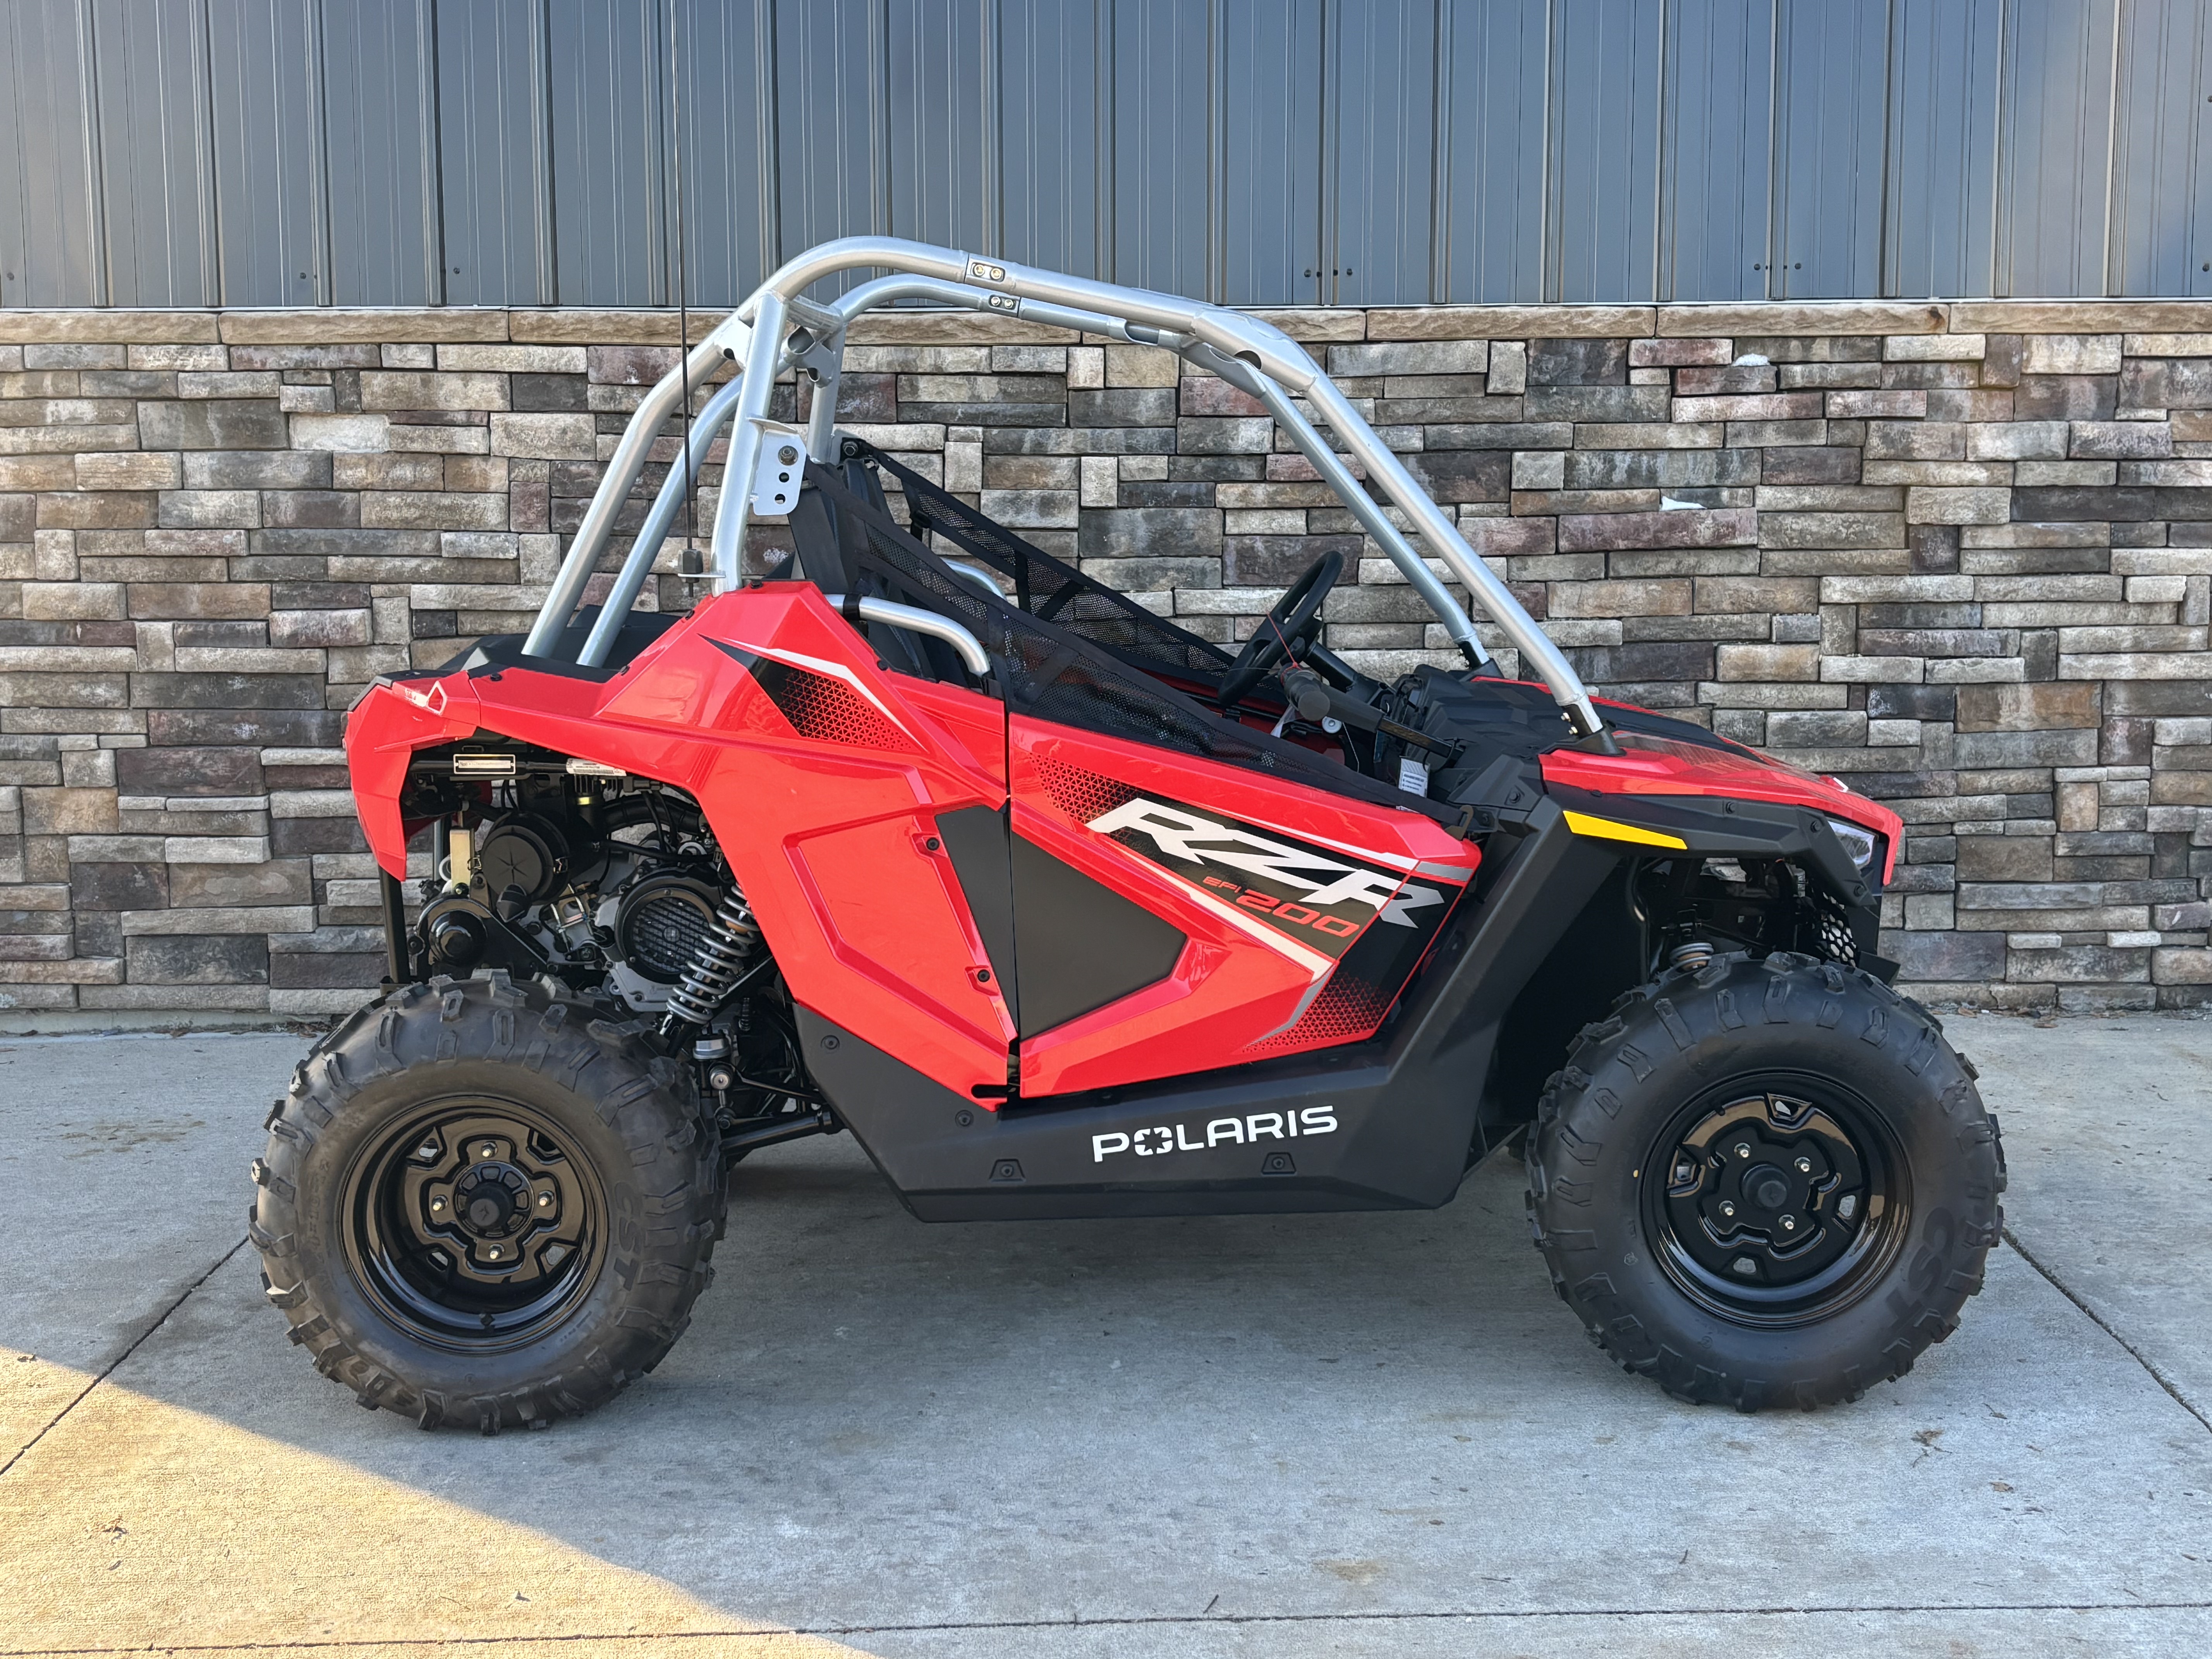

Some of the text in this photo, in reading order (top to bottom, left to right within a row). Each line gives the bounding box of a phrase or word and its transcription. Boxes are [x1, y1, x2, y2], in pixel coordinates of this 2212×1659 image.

[1084, 797, 1444, 928] RZR
[1202, 876, 1360, 938] EFI 200
[1092, 1105, 1338, 1162] POLARIS
[613, 1182, 643, 1291] CST
[1885, 1206, 1955, 1333] CST
